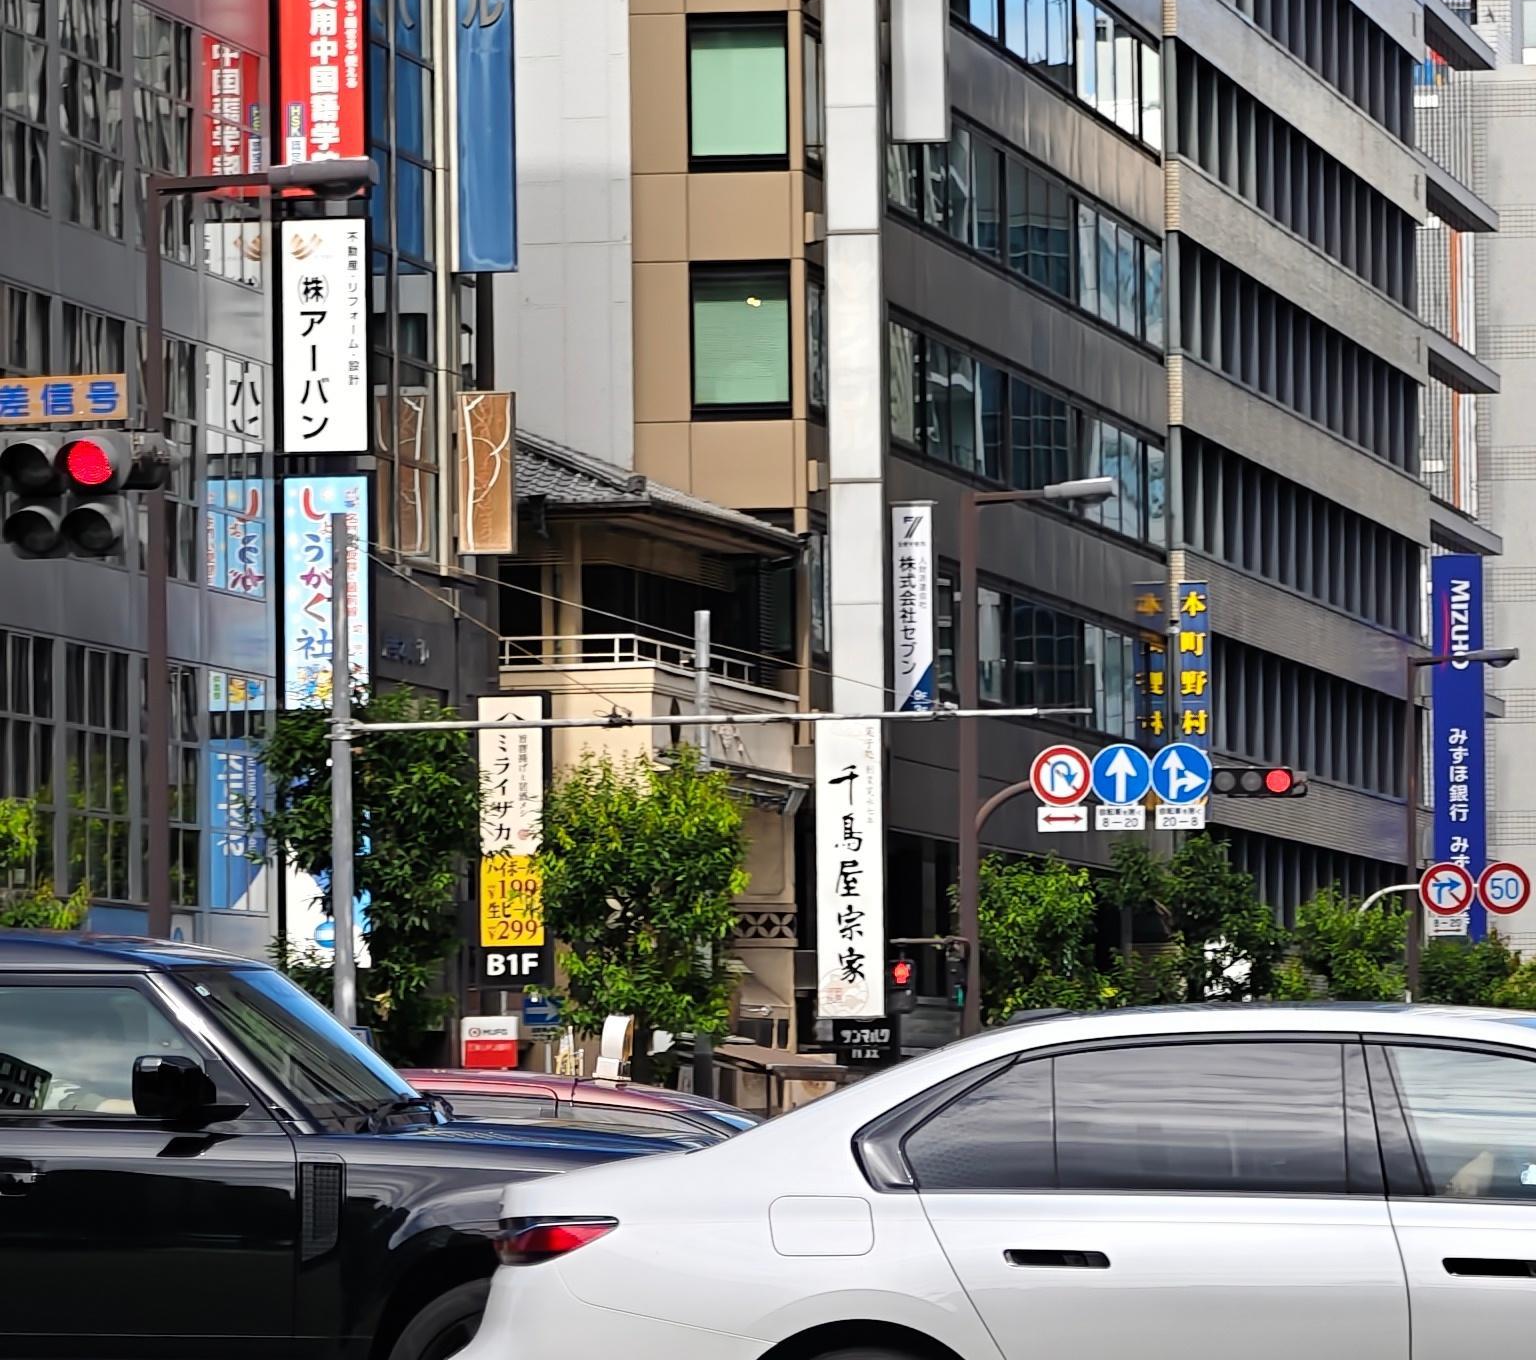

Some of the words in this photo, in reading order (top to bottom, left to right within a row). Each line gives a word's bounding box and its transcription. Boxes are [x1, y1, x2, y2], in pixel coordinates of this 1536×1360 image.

[0, 382, 119, 417] 差信号
[899, 556, 916, 675] 株式会社セブン
[1450, 580, 1470, 670] MIZUHO
[1180, 591, 1207, 805] 本町野村
[494, 734, 514, 841] ミライザカ
[1448, 728, 1469, 822] みずほ銀行
[827, 765, 865, 984] 千鳥屋宗家
[1490, 877, 1519, 901] 50
[487, 953, 539, 976] B1F
